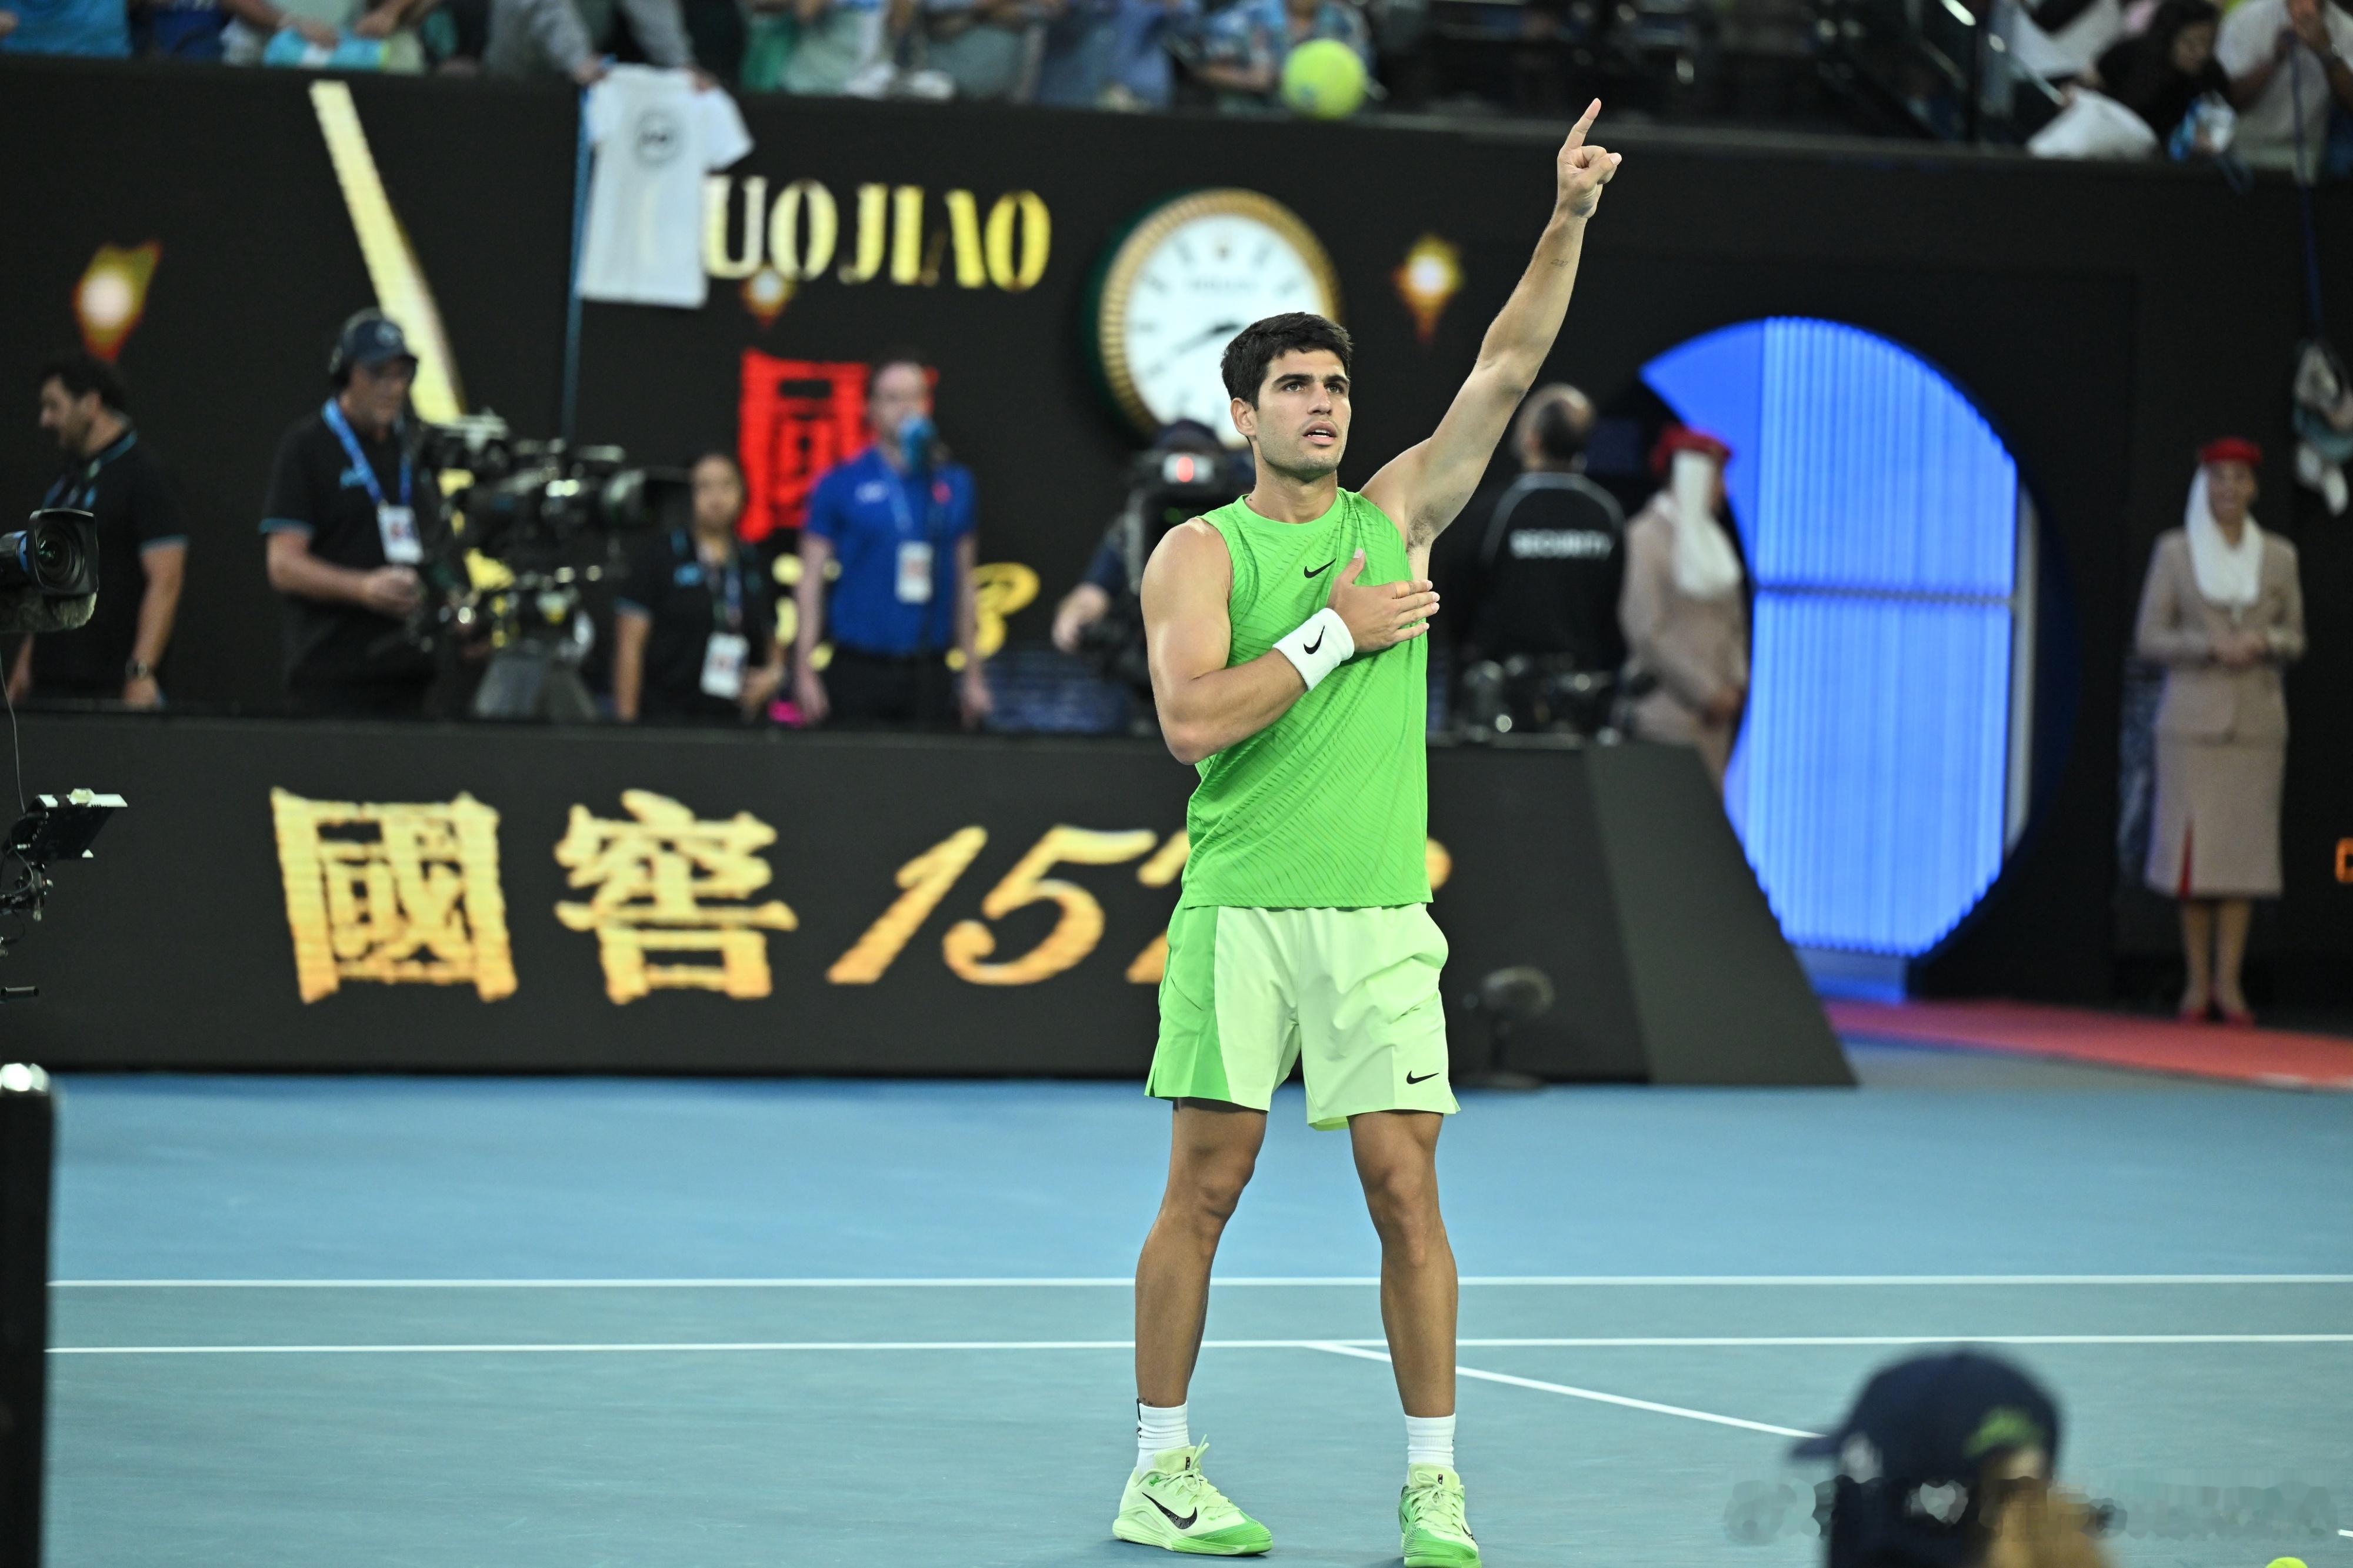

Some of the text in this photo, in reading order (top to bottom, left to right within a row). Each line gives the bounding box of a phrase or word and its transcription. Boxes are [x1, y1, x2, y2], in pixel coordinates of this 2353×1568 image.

[704, 175, 1052, 292] UOJIAO
[1511, 531, 1612, 558] SECURITY
[826, 824, 1451, 985] 15
